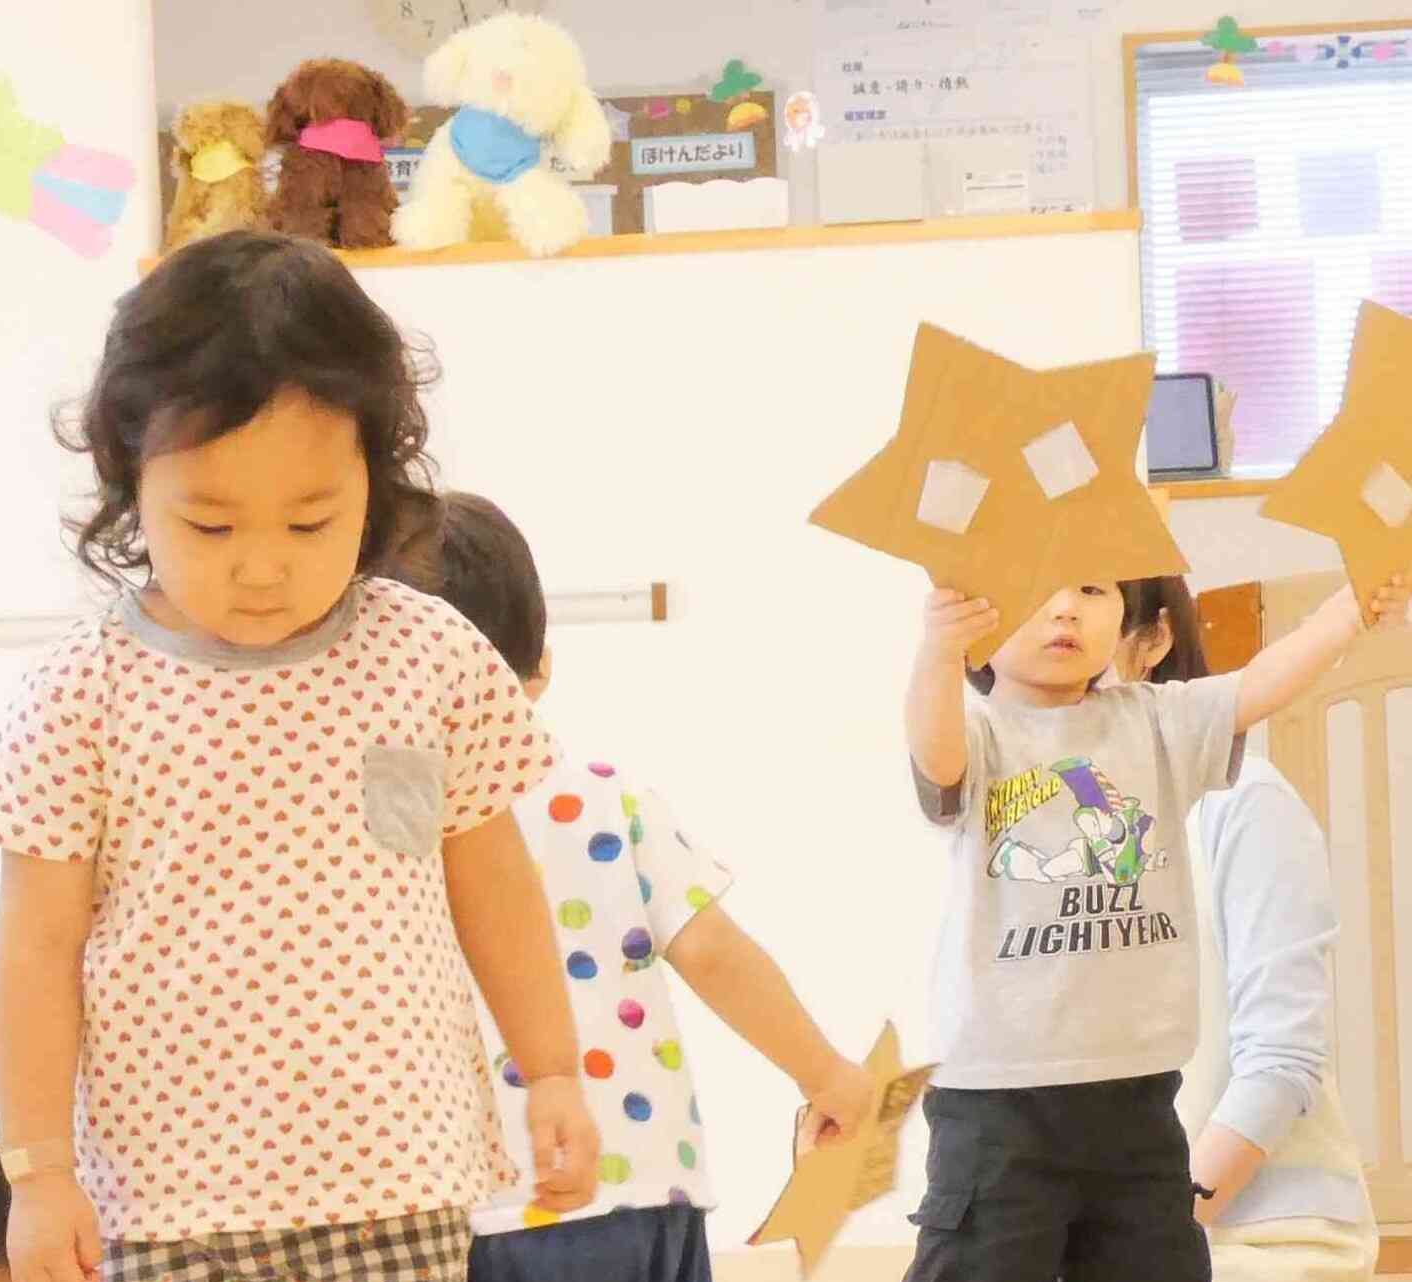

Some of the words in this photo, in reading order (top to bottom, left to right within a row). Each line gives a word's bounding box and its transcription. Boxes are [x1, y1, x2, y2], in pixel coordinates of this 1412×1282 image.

[641, 142, 743, 165] ほけんだより
[1058, 882, 1144, 918] BUZZ
[996, 911, 1178, 959] LIGHTYEAR
